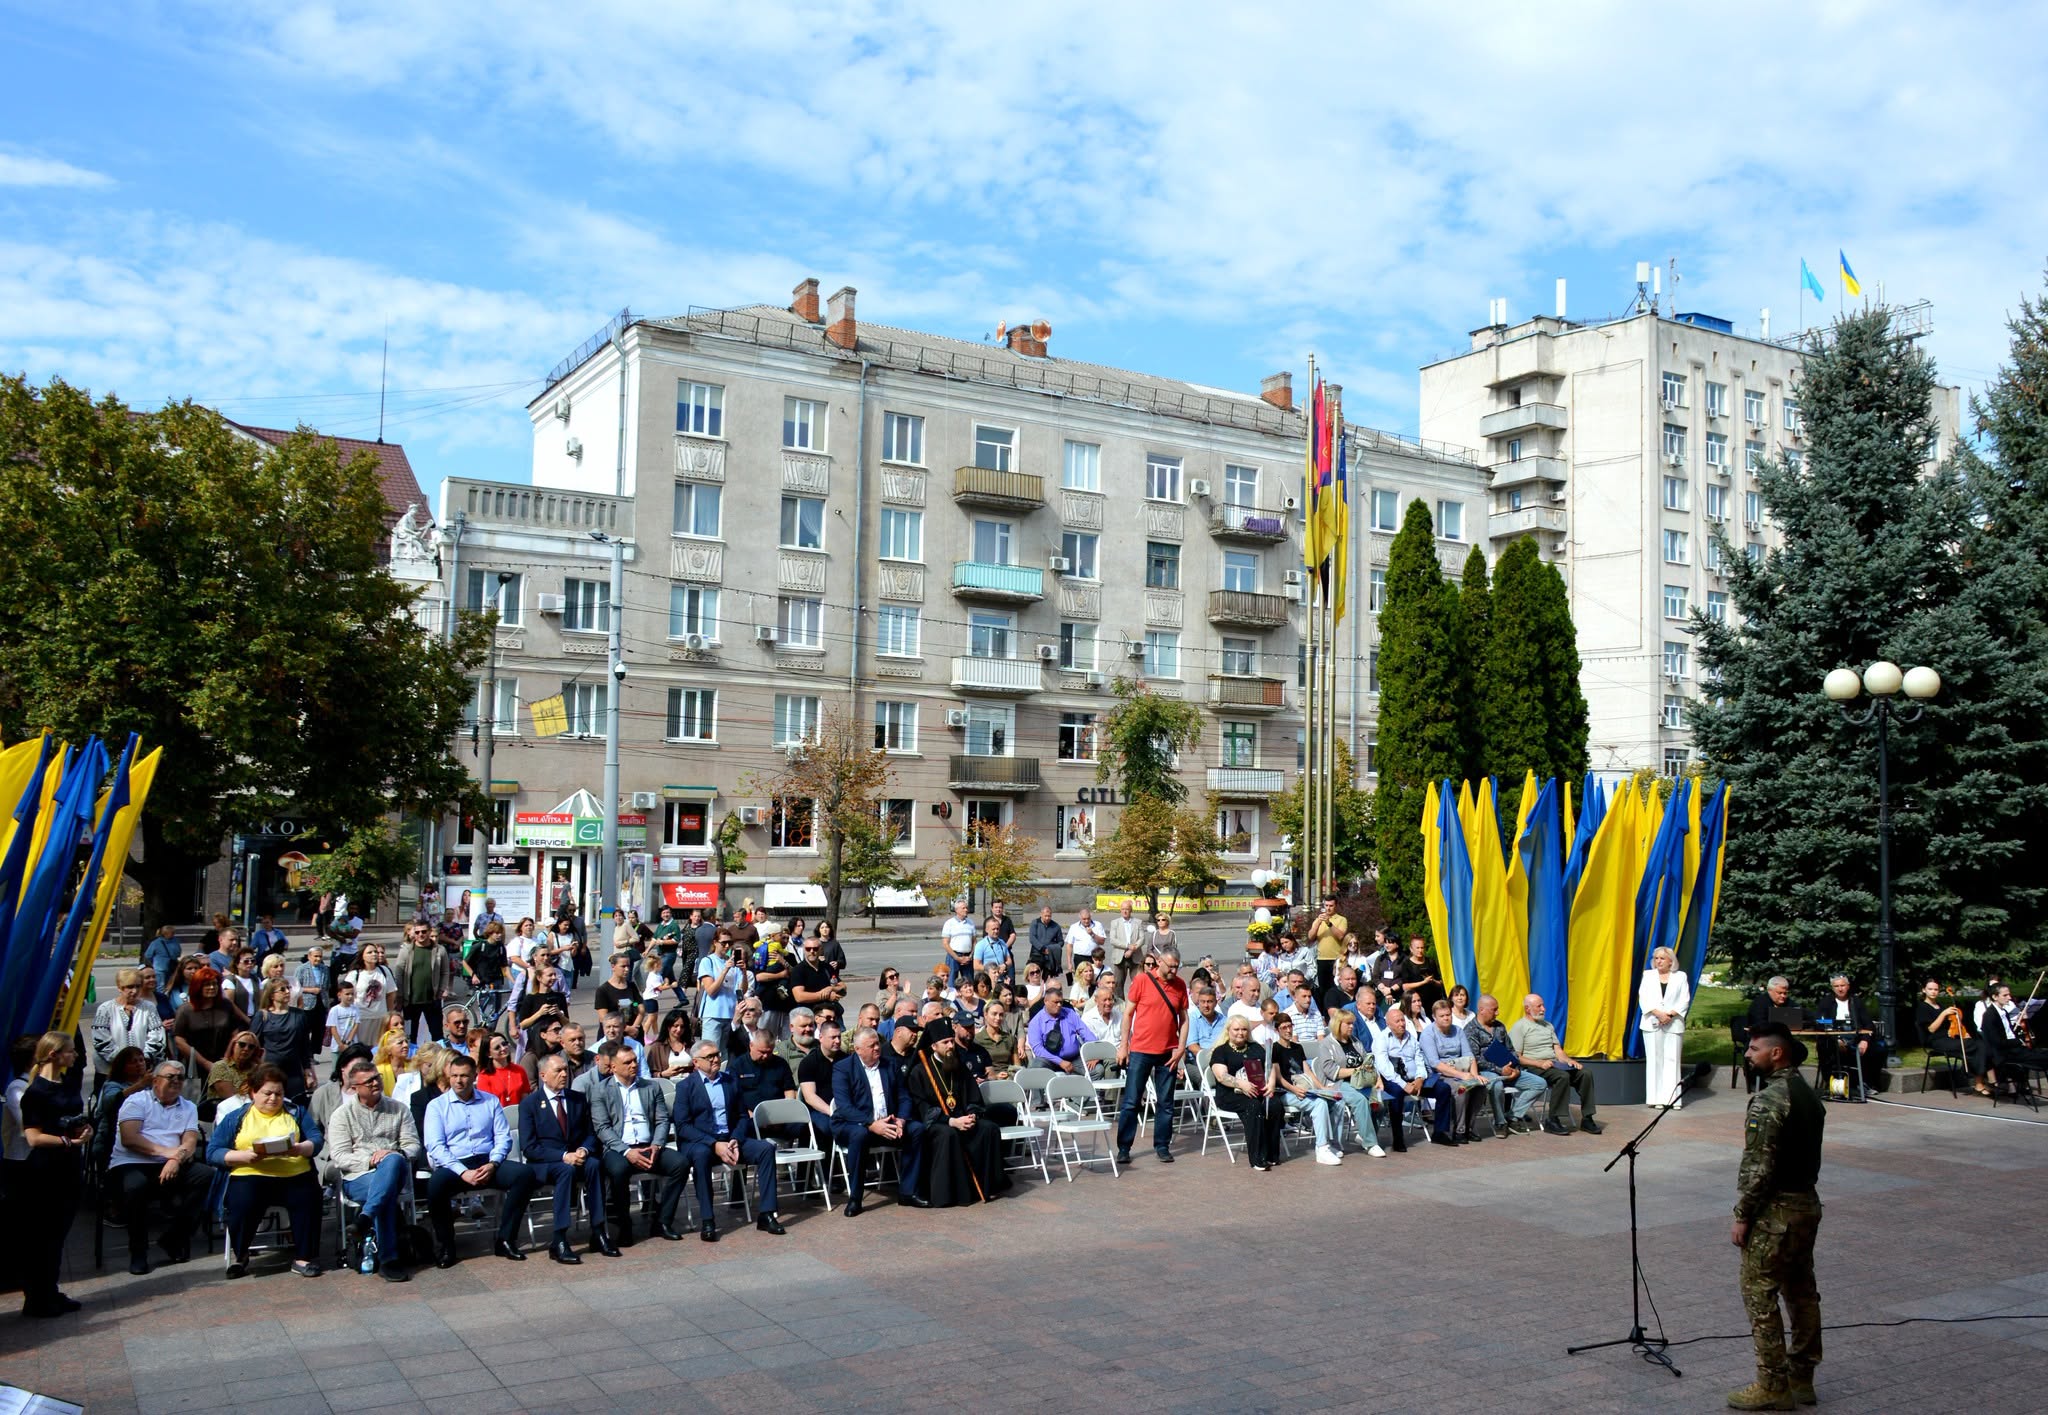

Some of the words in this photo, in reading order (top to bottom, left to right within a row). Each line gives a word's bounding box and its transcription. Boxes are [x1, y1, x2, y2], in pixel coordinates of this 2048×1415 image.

[527, 815, 562, 824] MILAVITSA
[529, 838, 567, 847] SERVICE
[497, 856, 516, 867] Style
